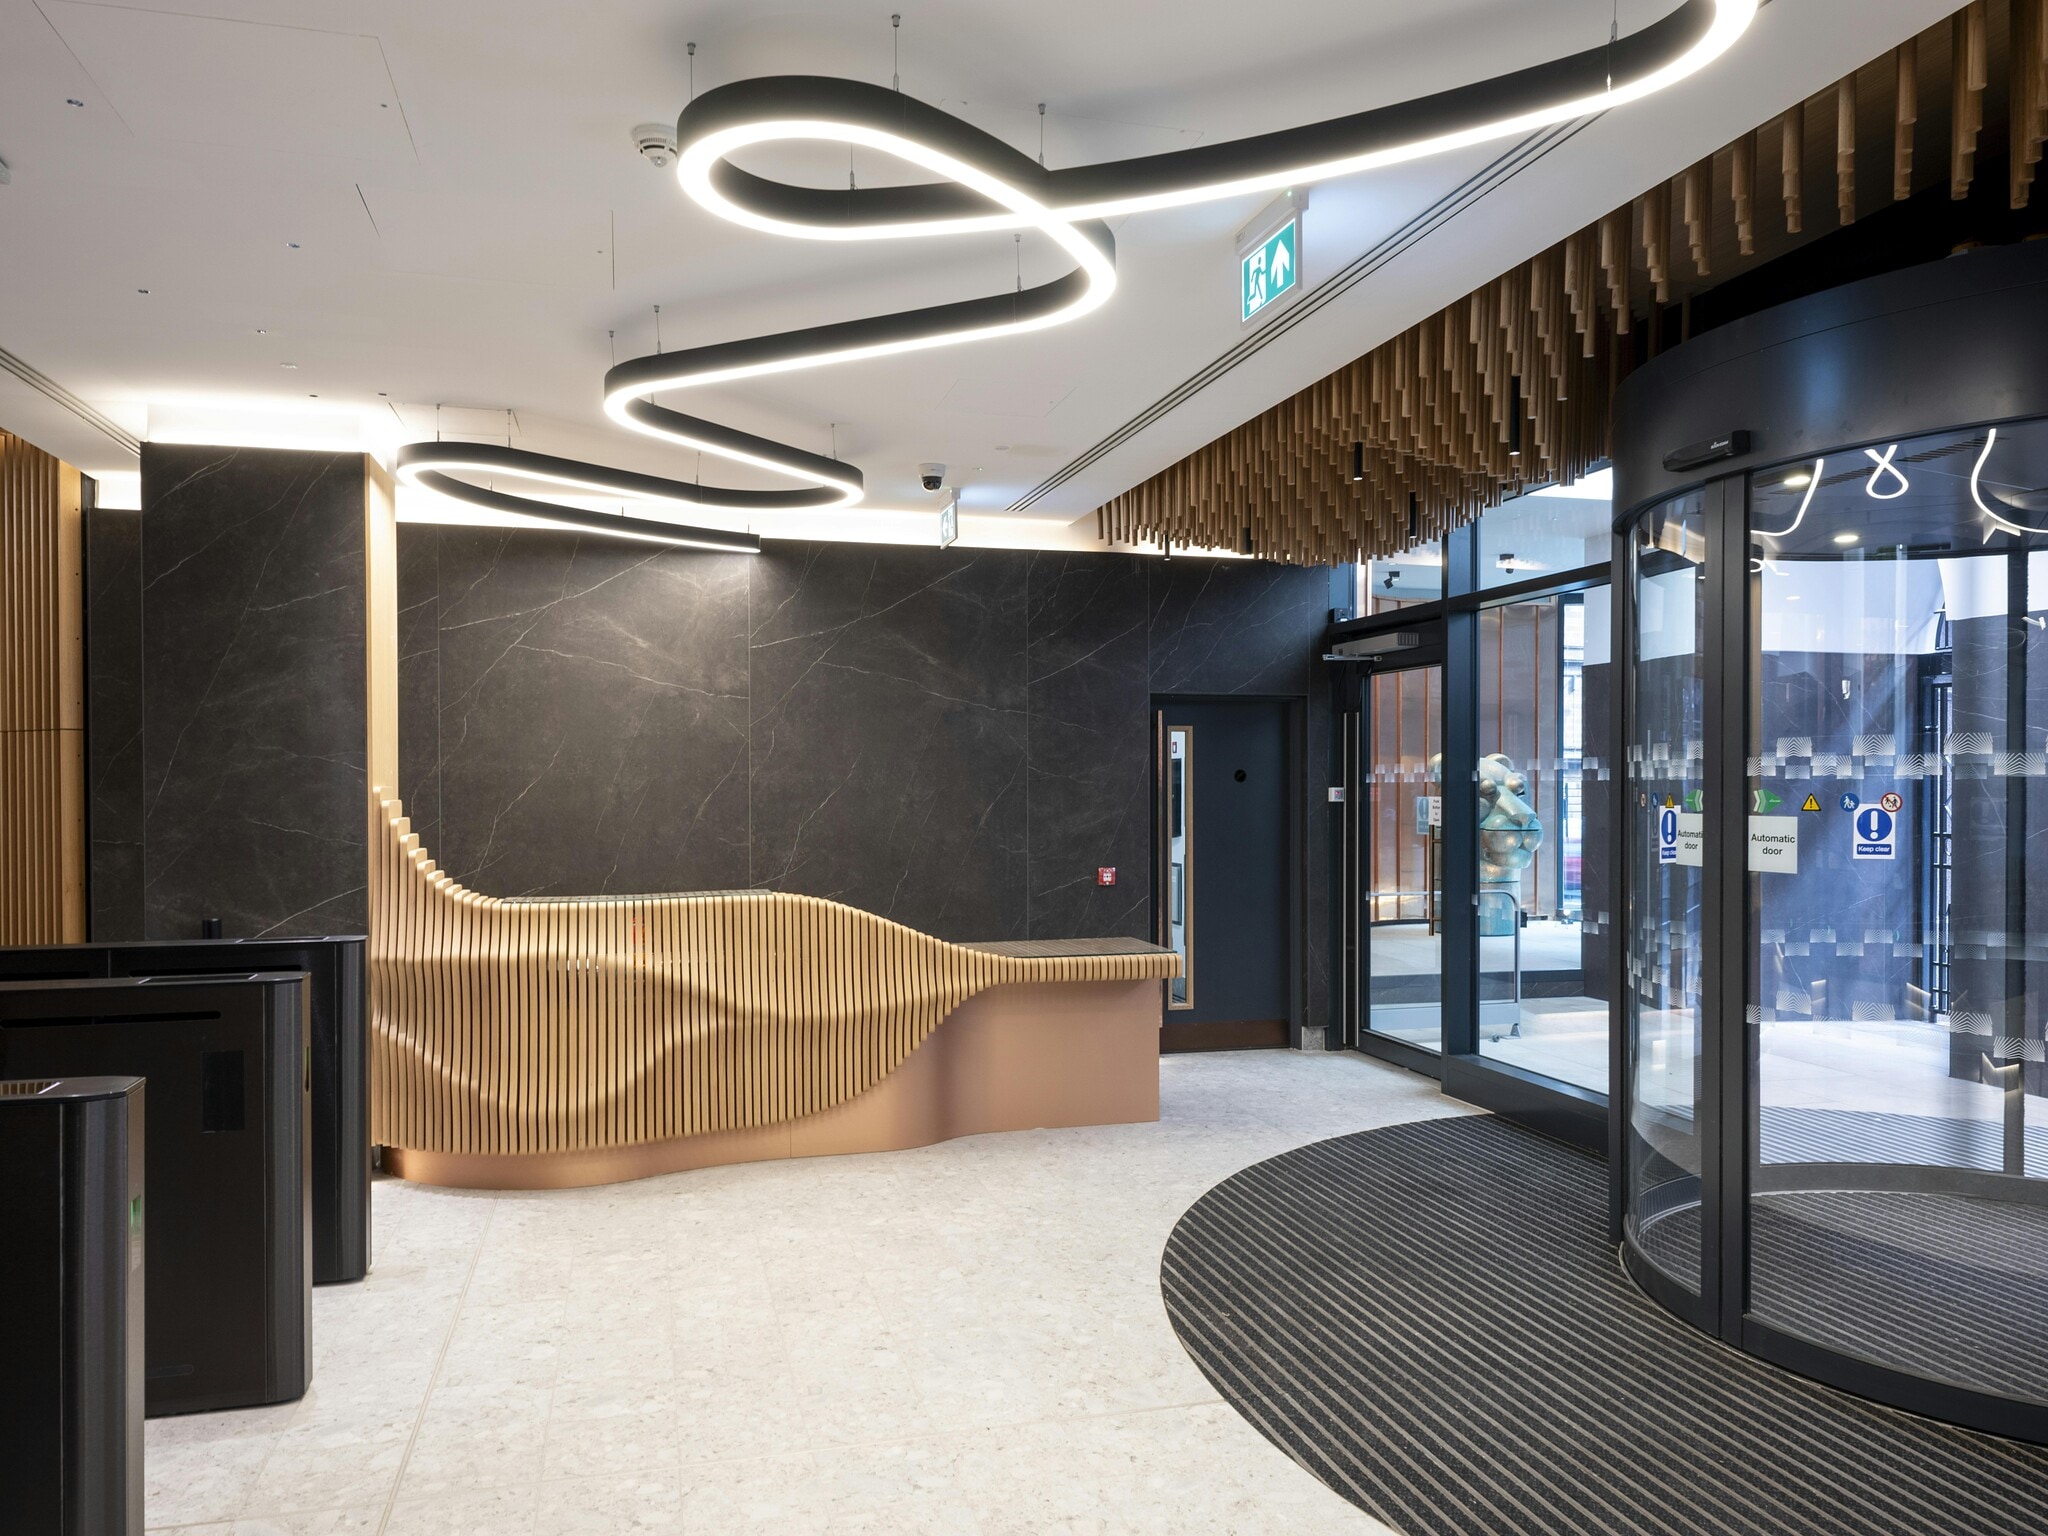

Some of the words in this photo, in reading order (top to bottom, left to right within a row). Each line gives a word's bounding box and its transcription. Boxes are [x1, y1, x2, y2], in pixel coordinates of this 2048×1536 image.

[1678, 830, 1703, 838] Automati
[1751, 833, 1796, 843] Automatic
[1685, 841, 1698, 850] door
[1762, 846, 1783, 855] door
